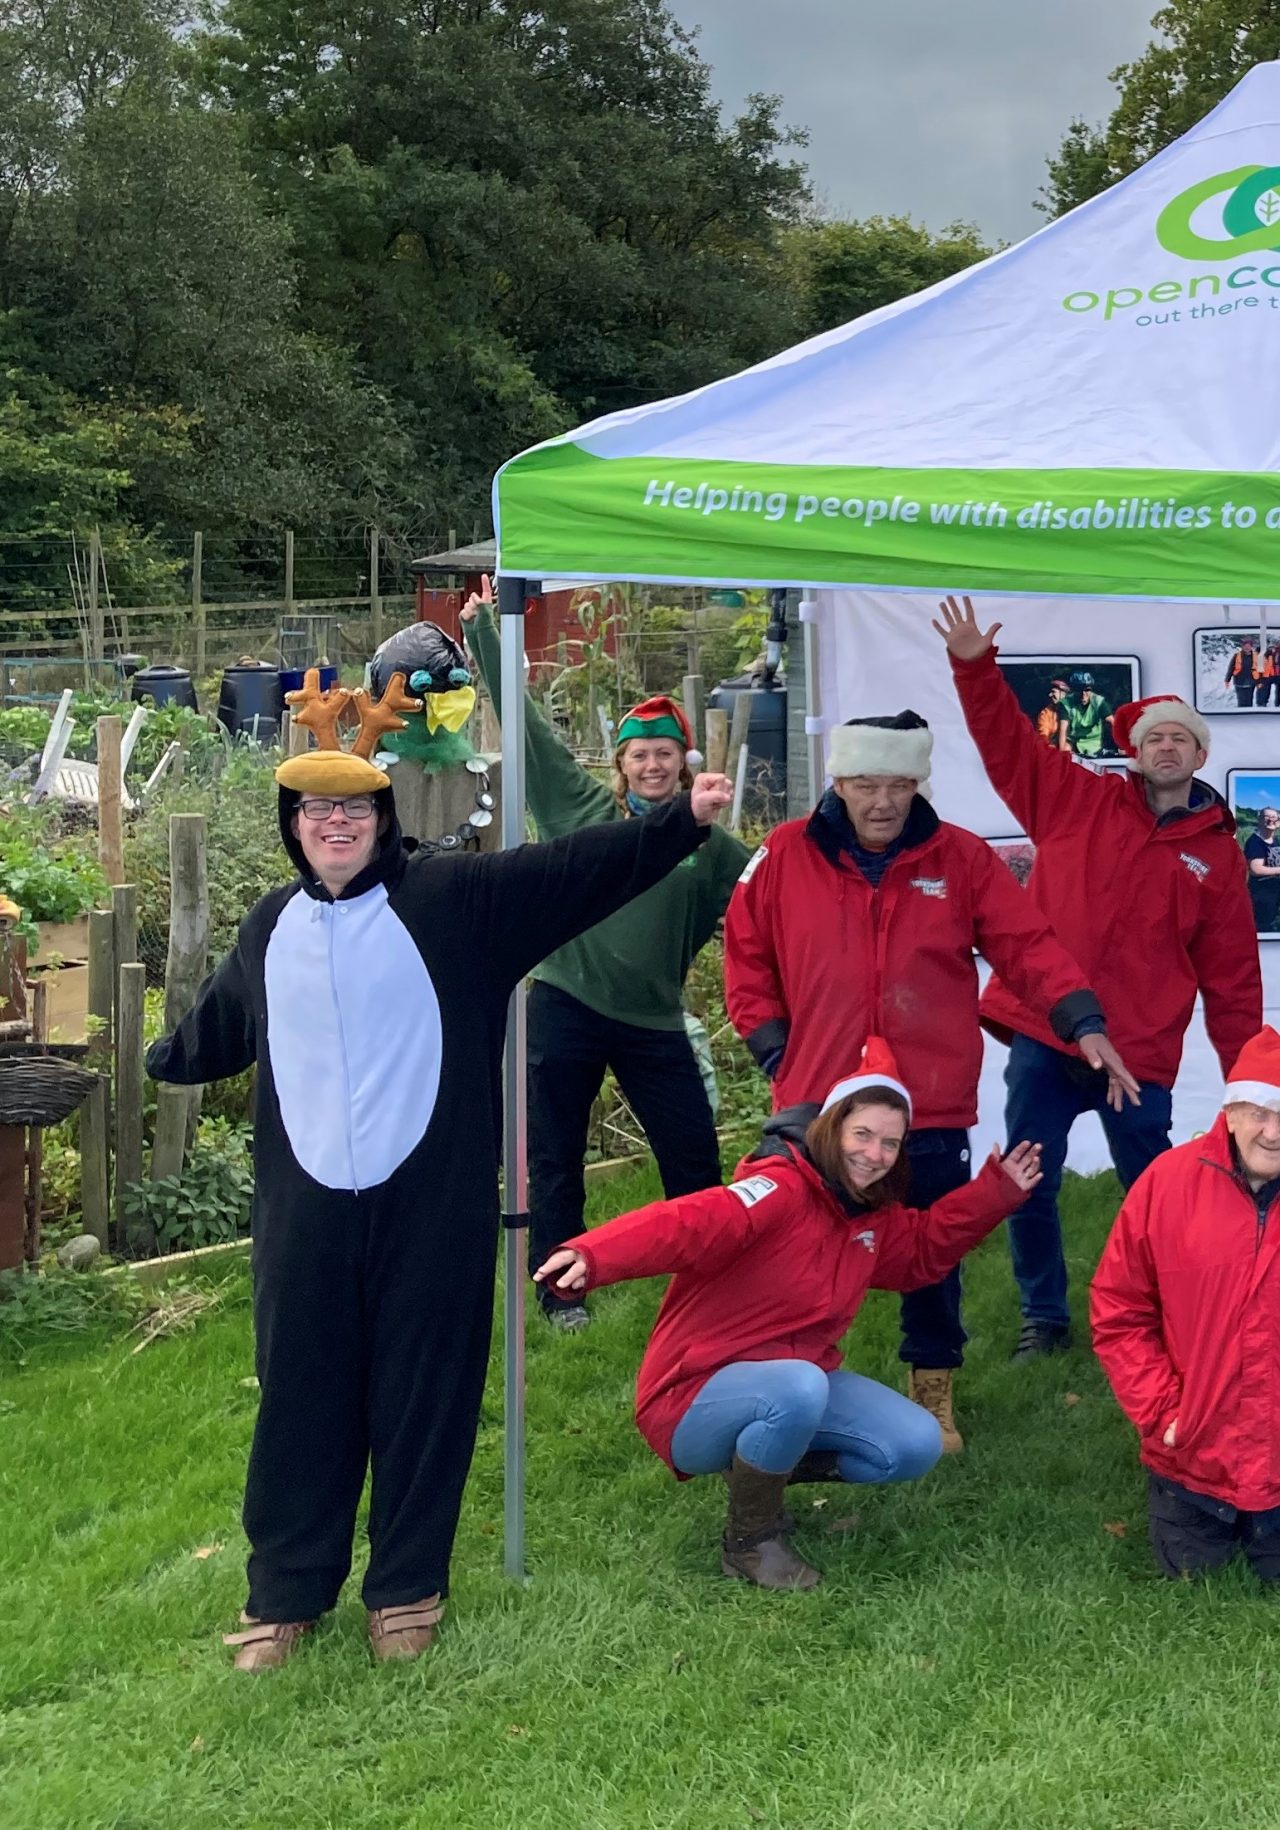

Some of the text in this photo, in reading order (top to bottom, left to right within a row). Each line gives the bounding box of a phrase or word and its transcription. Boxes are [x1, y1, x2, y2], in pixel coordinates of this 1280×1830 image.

[1136, 309, 1180, 326] out
[1189, 296, 1259, 319] there
[643, 479, 787, 521] Helping
[794, 495, 921, 527] people
[930, 500, 1007, 527] with
[1016, 498, 1212, 530] disabilities
[1220, 501, 1256, 528] to
